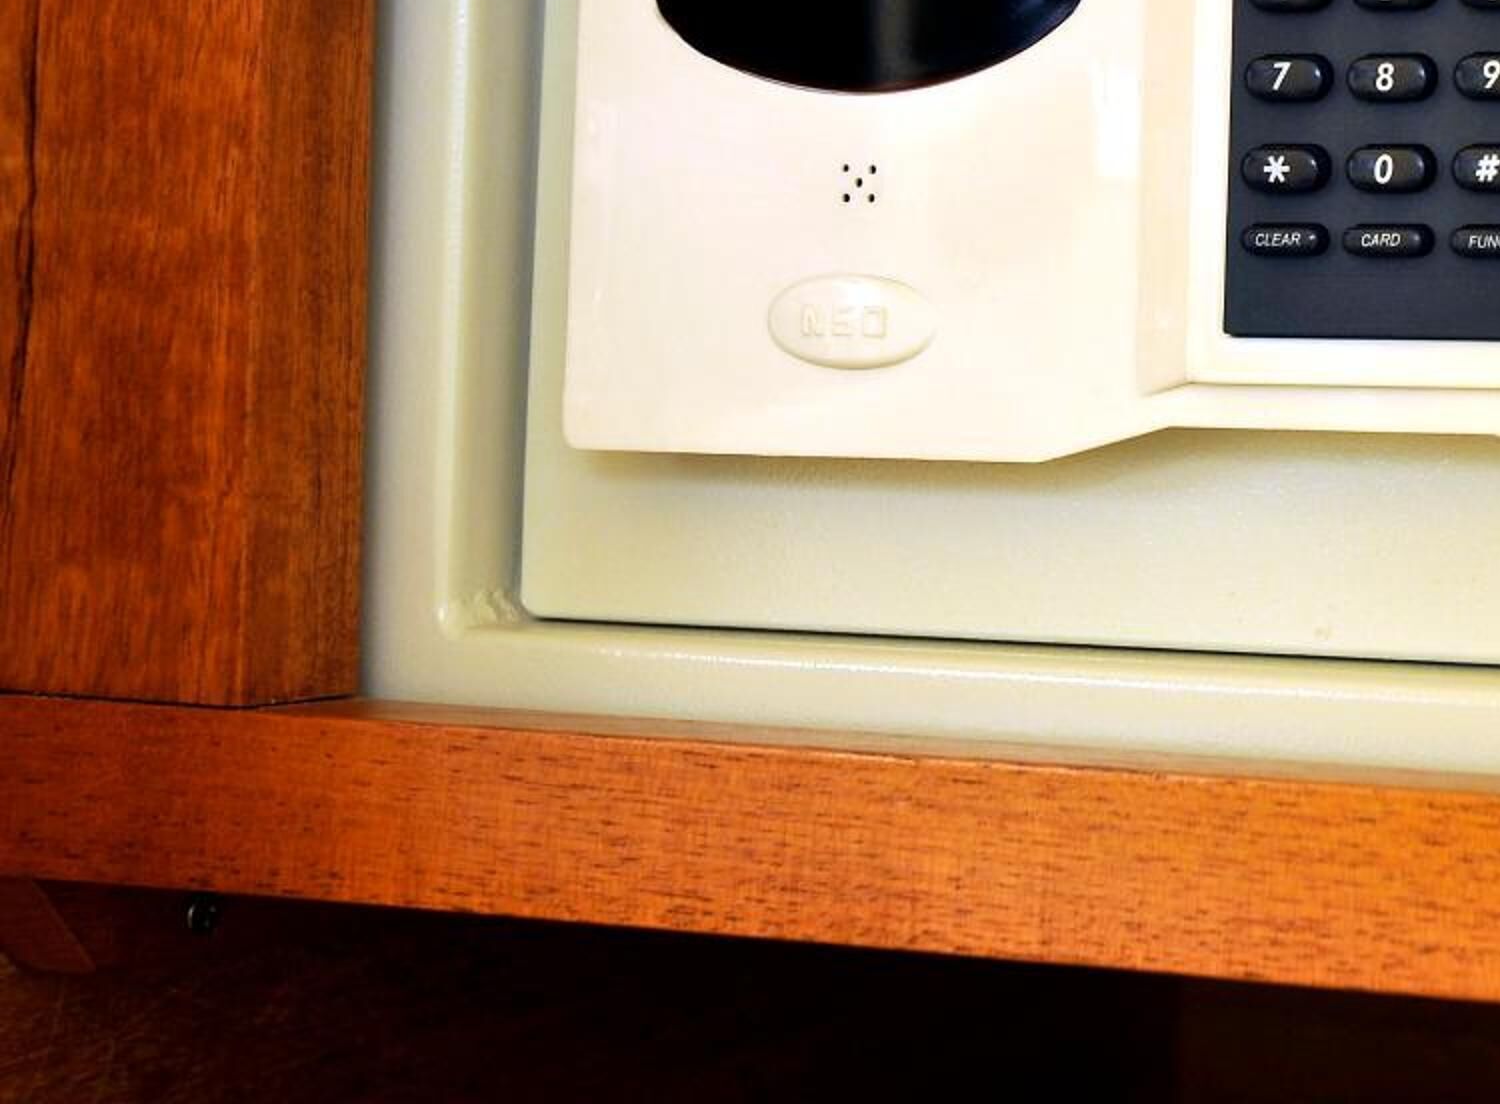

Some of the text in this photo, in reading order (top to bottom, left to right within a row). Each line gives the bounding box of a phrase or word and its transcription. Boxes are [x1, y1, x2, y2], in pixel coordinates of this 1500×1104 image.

[1272, 63, 1291, 91] 7
[1375, 63, 1395, 92] 8
[1482, 61, 1500, 89] 9
[1373, 155, 1393, 185] 0
[1475, 154, 1500, 183] #
[1255, 233, 1301, 246] CLEAR
[1361, 233, 1401, 247] CARD
